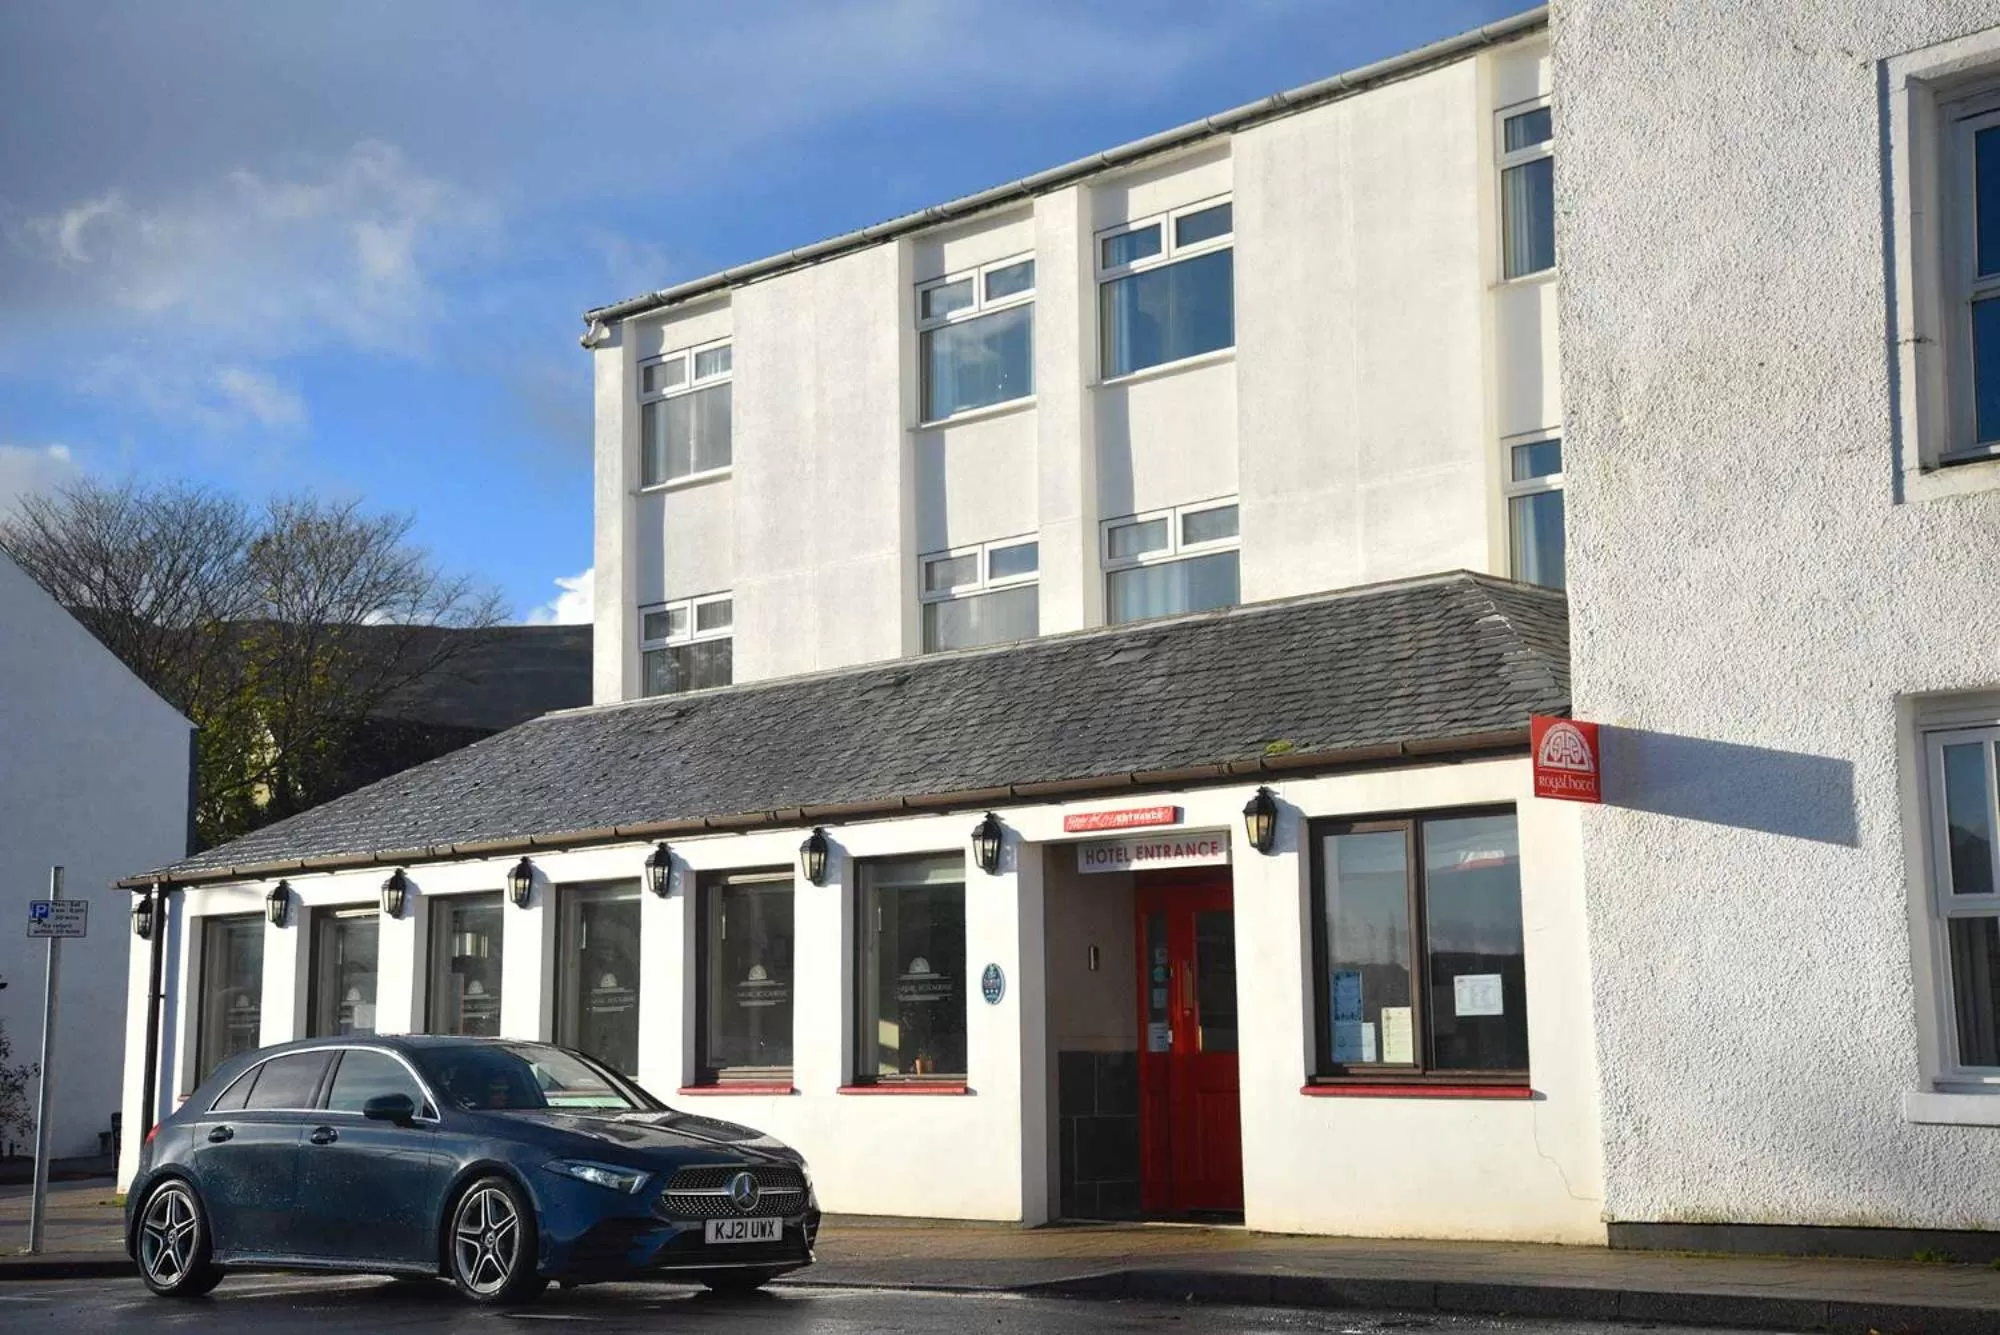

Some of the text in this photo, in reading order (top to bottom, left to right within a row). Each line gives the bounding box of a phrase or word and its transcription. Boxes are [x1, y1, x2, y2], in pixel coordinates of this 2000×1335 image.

[1086, 841, 1219, 865] HOTEL ENTRANCE
[35, 904, 47, 918] P
[715, 1220, 775, 1240] KJ21 UWX
